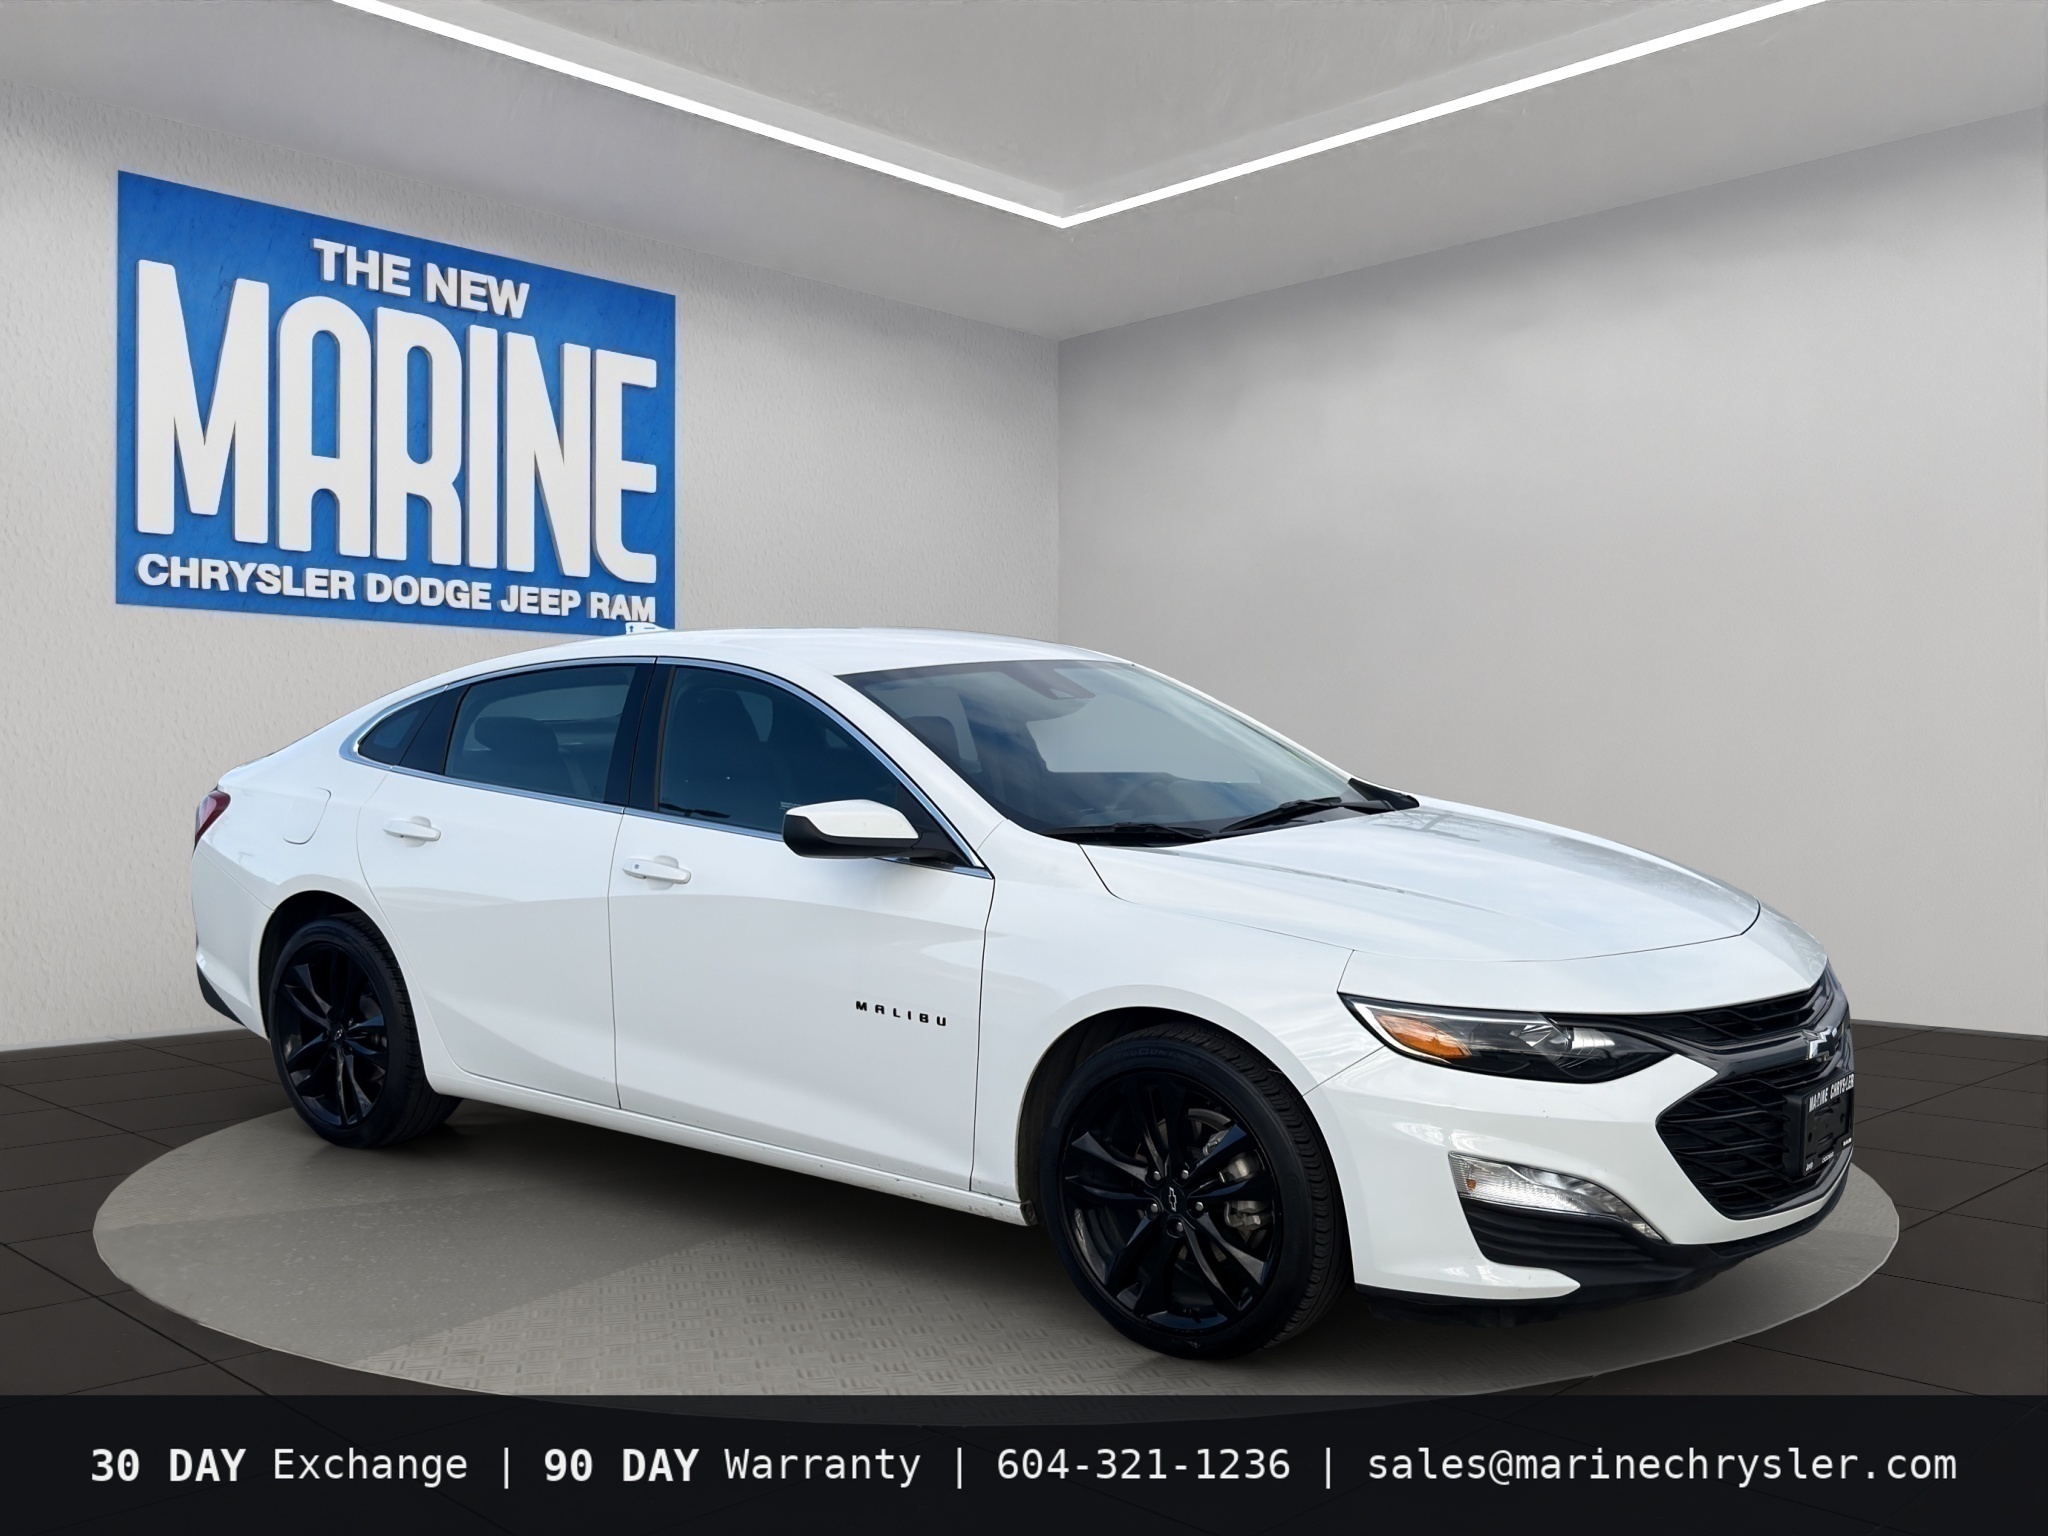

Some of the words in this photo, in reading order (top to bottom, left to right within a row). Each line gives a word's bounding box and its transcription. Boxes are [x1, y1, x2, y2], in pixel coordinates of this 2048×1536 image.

[312, 238, 411, 297] THE
[424, 262, 530, 319] NEW
[136, 259, 657, 583] MARINE
[136, 553, 356, 601] CHRYSLER
[364, 573, 492, 611] DODGE
[498, 585, 581, 616] JEEP
[587, 591, 656, 622] RAM
[855, 1000, 947, 1027] MALIBU
